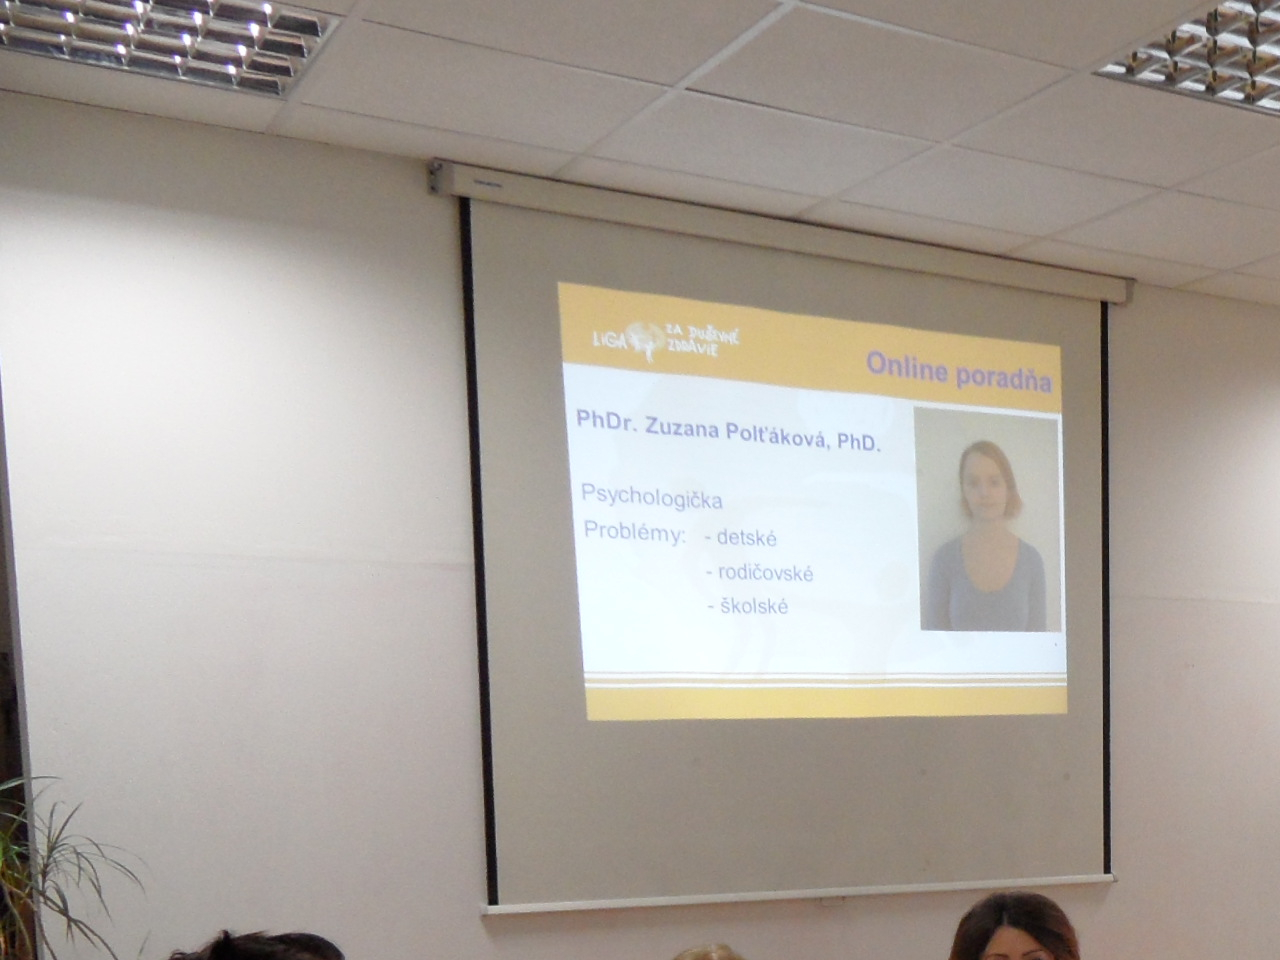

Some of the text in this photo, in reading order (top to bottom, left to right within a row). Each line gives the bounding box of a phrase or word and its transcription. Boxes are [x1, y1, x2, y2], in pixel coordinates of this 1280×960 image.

[866, 350, 1054, 394] Online poradňa
[576, 408, 638, 432] PhDr.
[645, 415, 720, 439] Zuzana
[837, 432, 882, 452] PhD.
[581, 482, 723, 512] Psychologička
[584, 519, 686, 547] Problémy:
[717, 528, 778, 547] detské
[718, 563, 814, 583] rodičovské
[720, 597, 789, 615] školské
